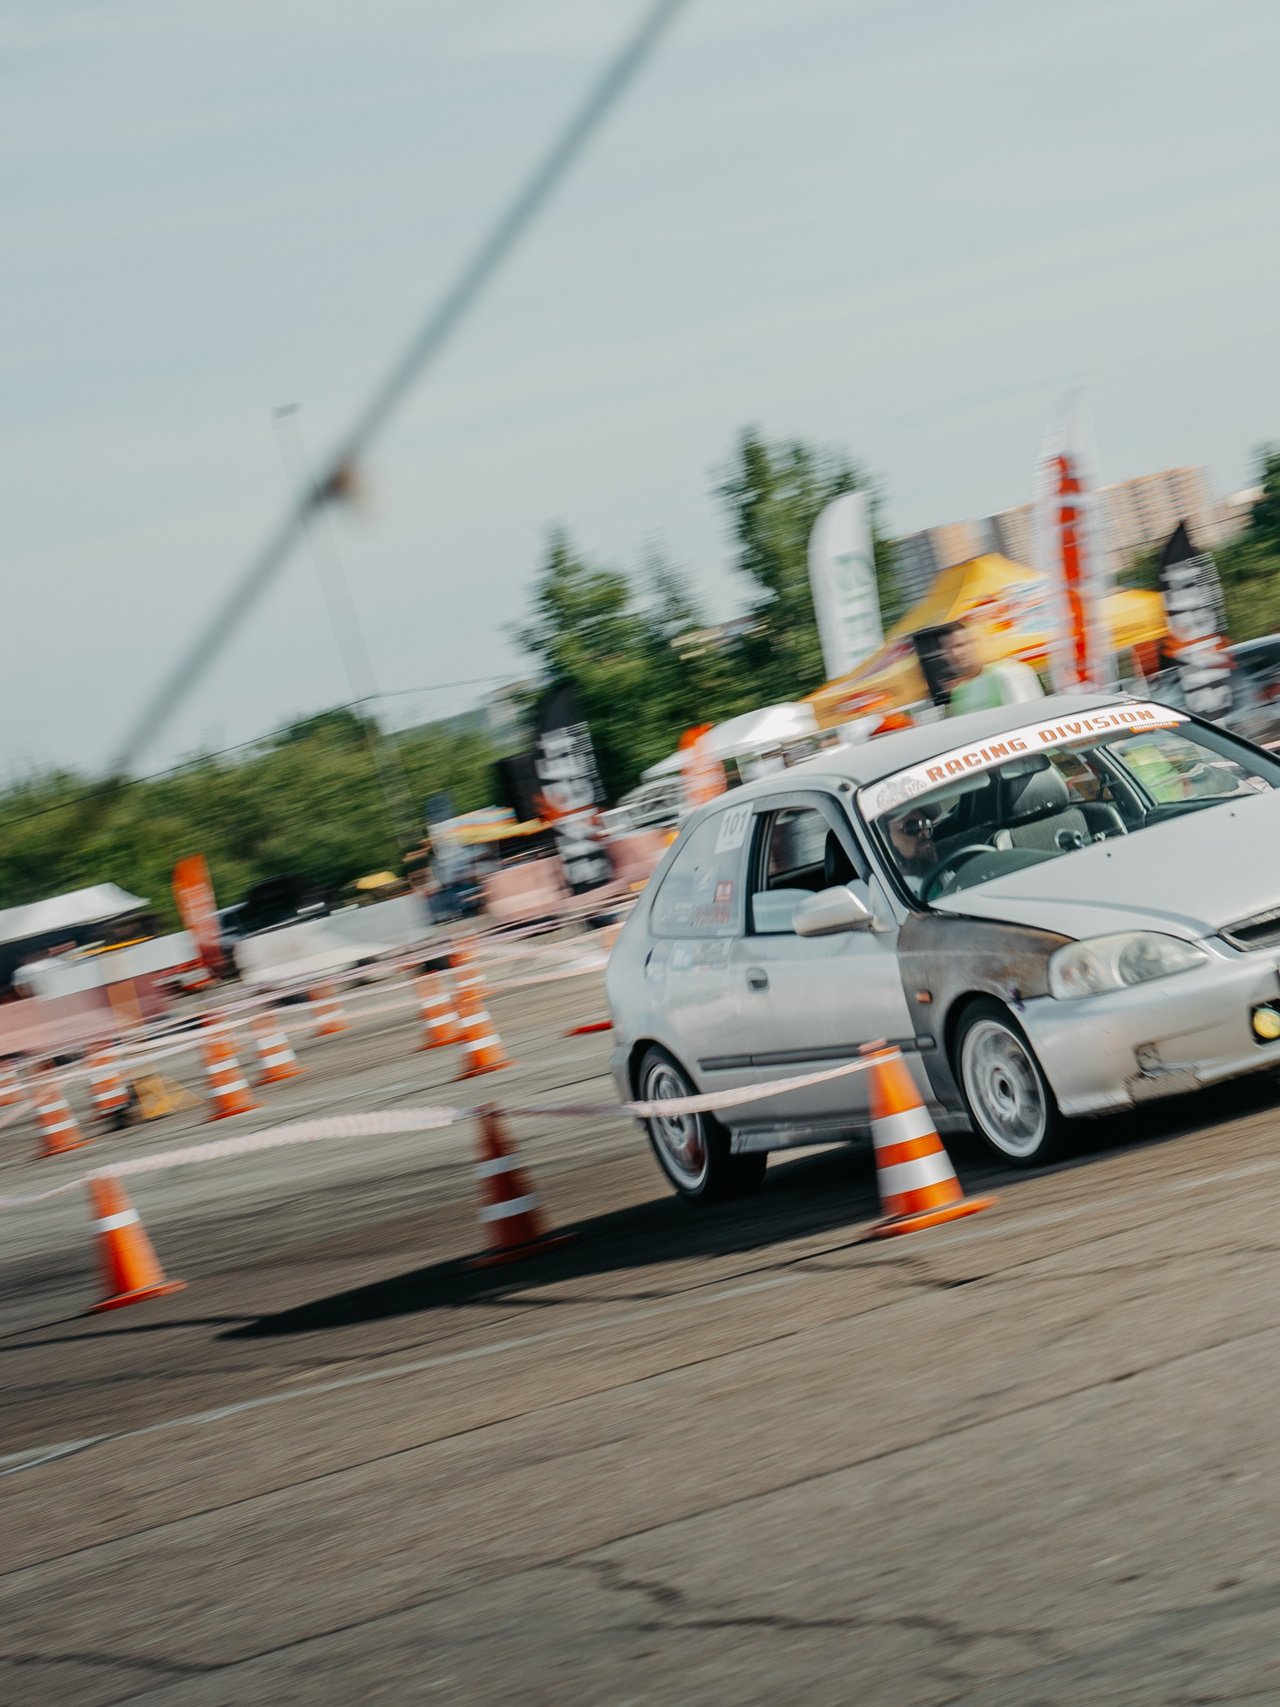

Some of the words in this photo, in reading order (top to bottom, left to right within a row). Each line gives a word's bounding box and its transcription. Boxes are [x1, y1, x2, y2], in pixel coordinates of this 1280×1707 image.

[926, 738, 1028, 783] RACING
[1037, 709, 1156, 744] DIVISION
[723, 810, 748, 837] 101
